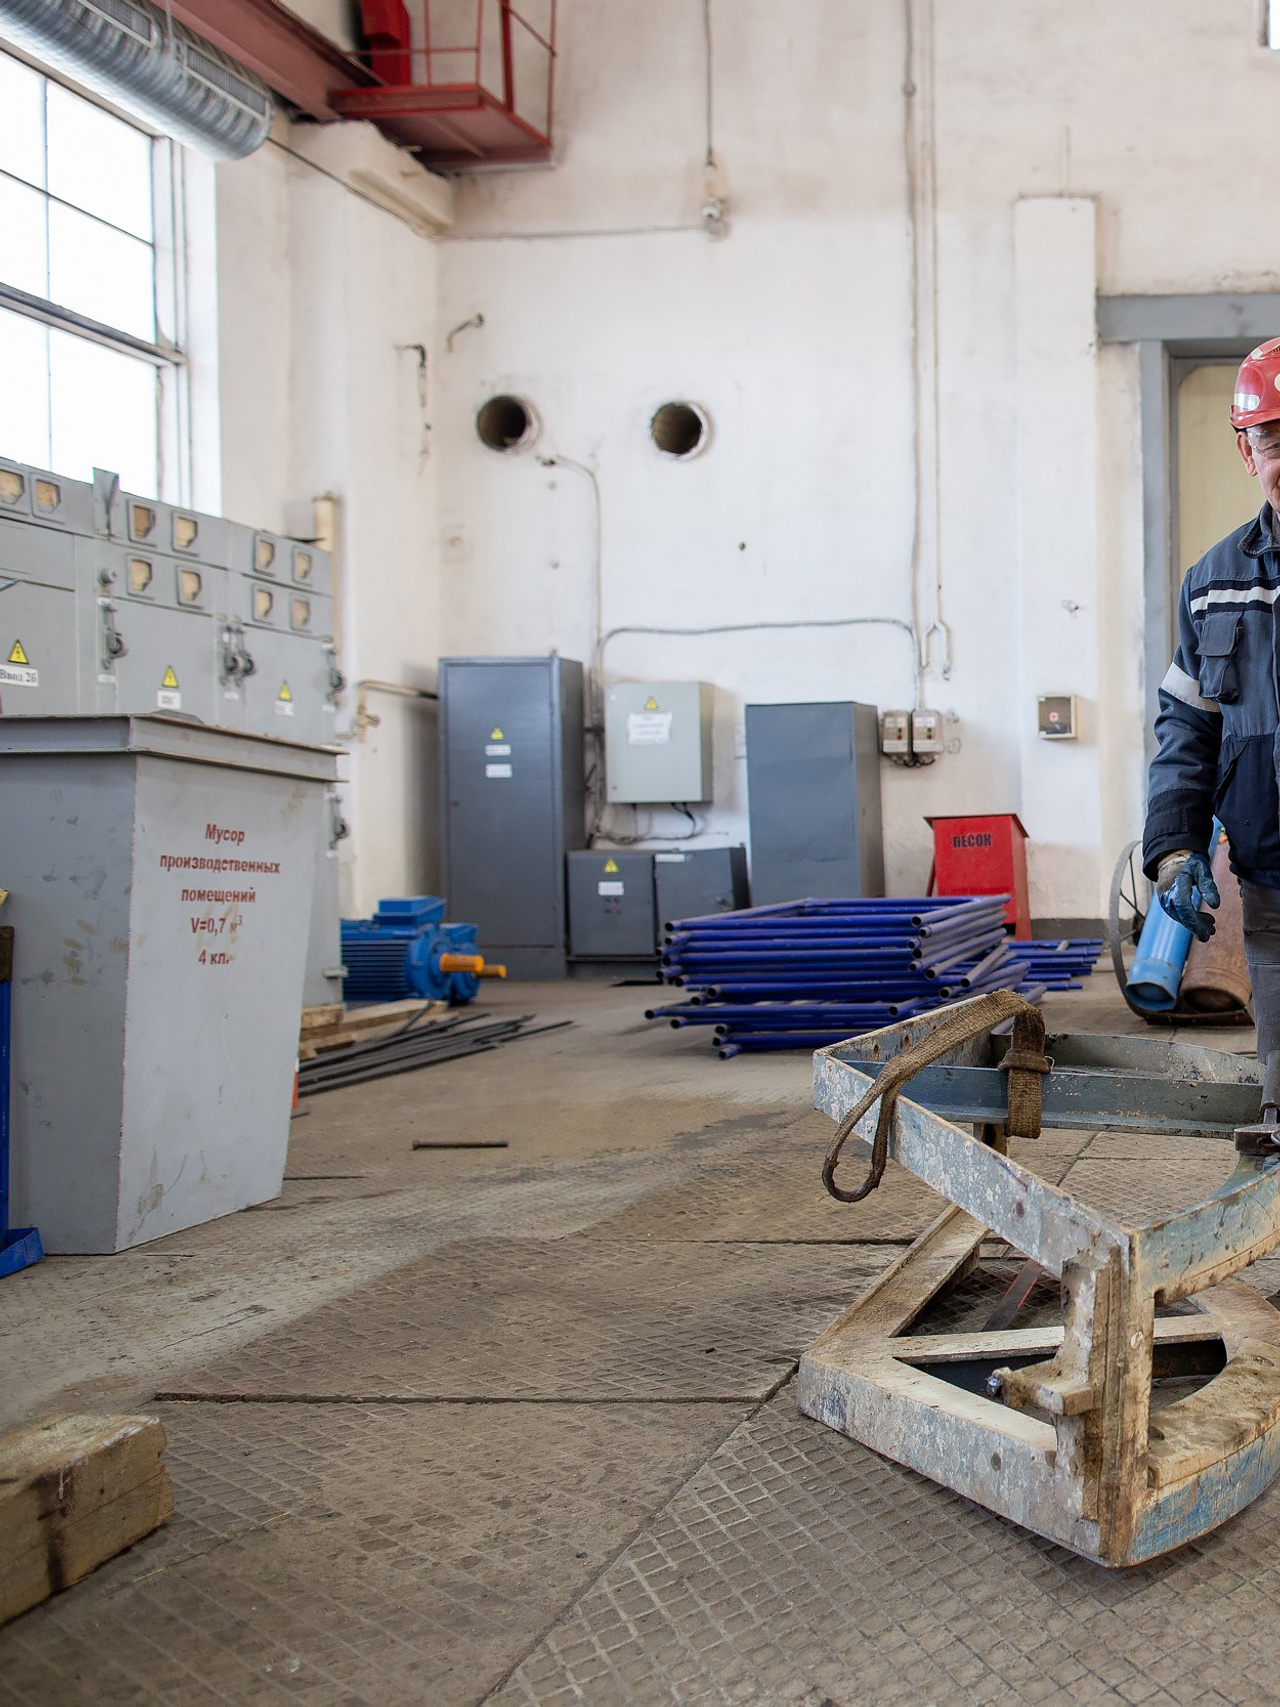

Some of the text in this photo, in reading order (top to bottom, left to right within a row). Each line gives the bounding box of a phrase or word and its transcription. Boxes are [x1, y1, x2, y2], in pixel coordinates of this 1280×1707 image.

[205, 823, 245, 846] Мусор
[952, 833, 992, 849] ПЕСОК
[159, 854, 281, 874] производственных
[181, 887, 256, 905] помещений
[190, 916, 227, 937] V=0,7
[198, 949, 207, 965] 4
